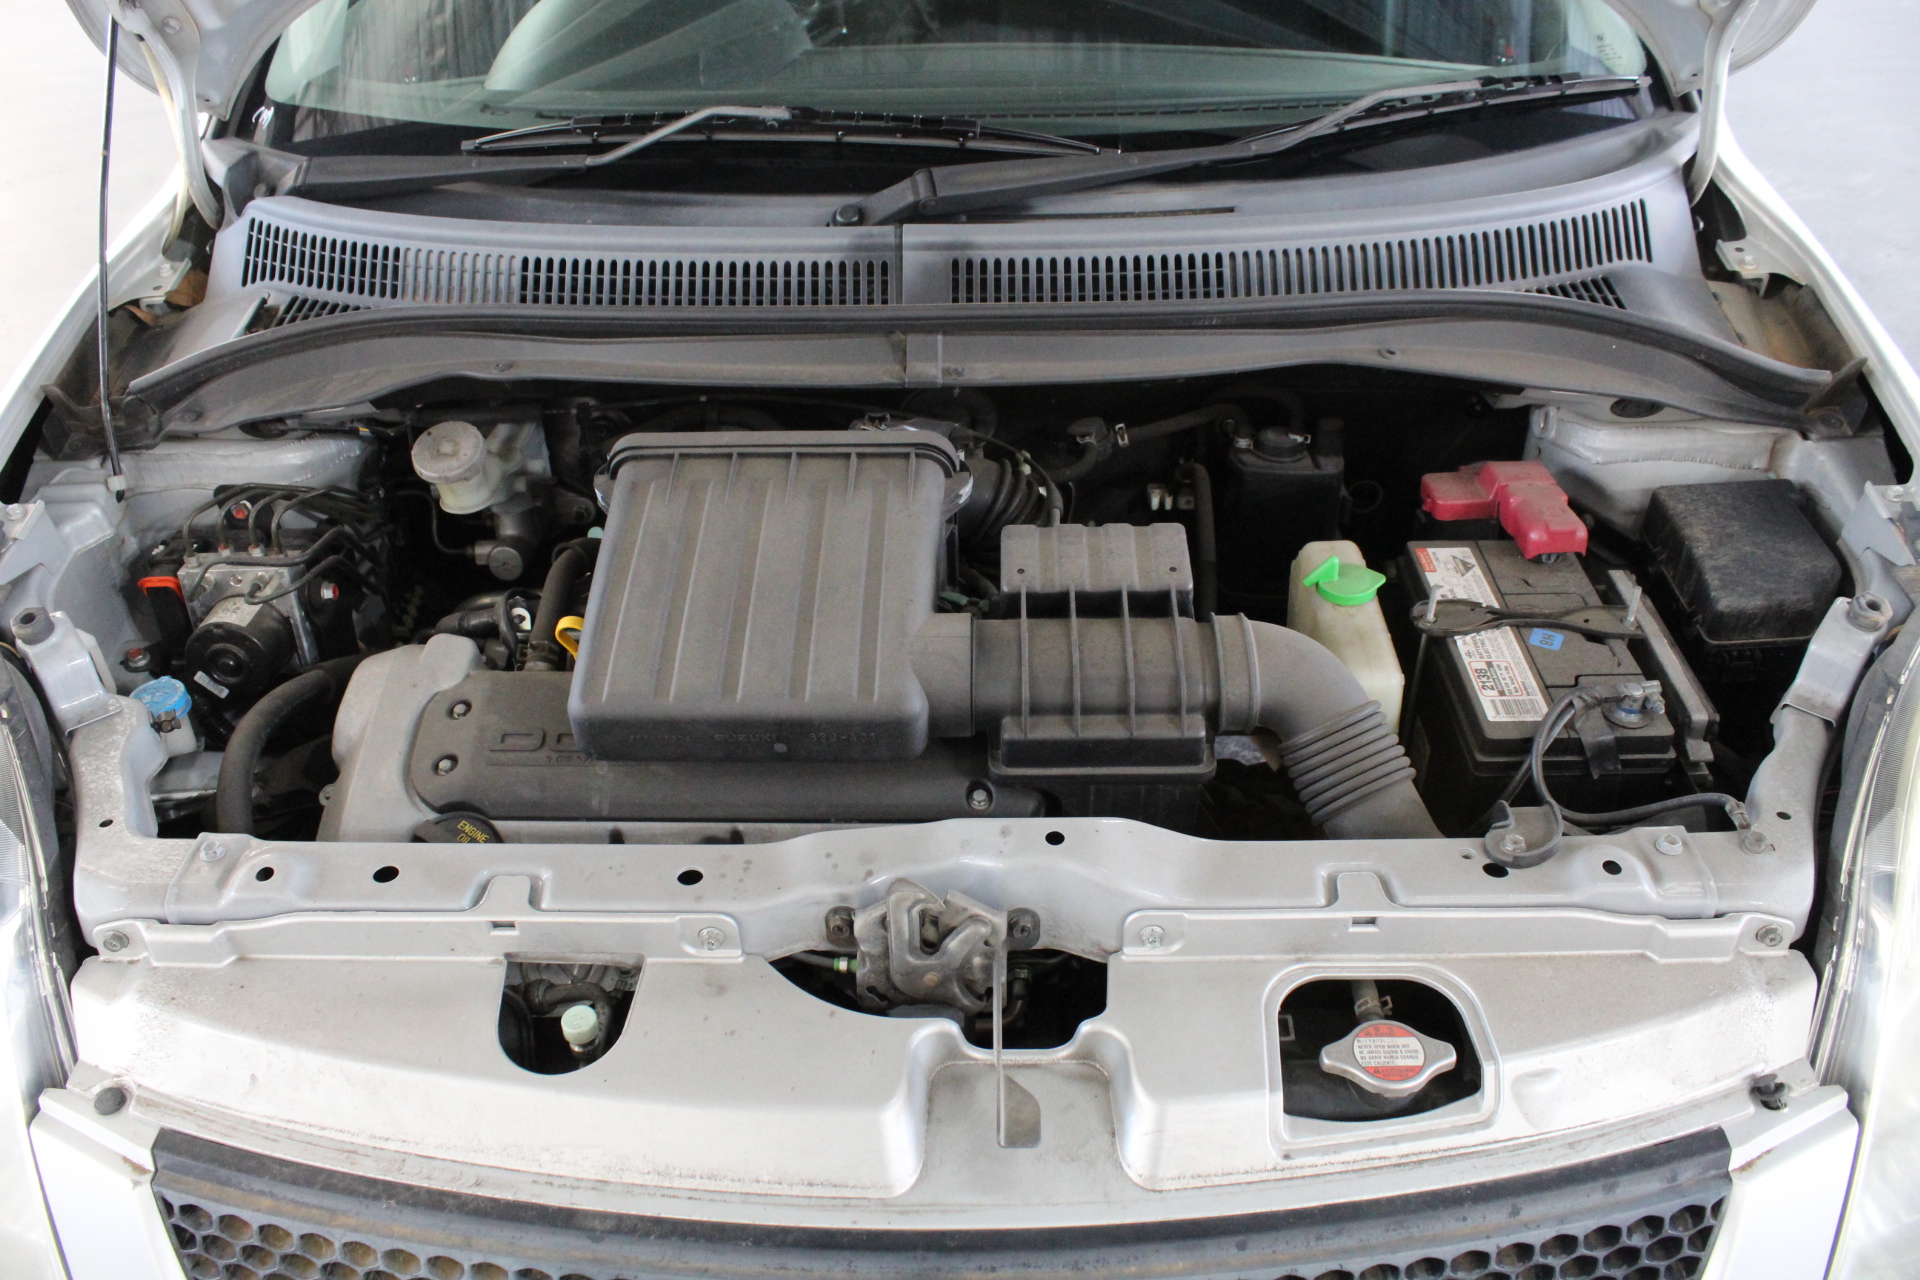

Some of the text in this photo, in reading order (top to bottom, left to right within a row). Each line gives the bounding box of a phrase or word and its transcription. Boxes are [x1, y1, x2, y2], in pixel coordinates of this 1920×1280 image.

[1474, 668, 1495, 690] 2138
[714, 733, 776, 742] SUZUKI
[457, 820, 489, 843] ENGINE
